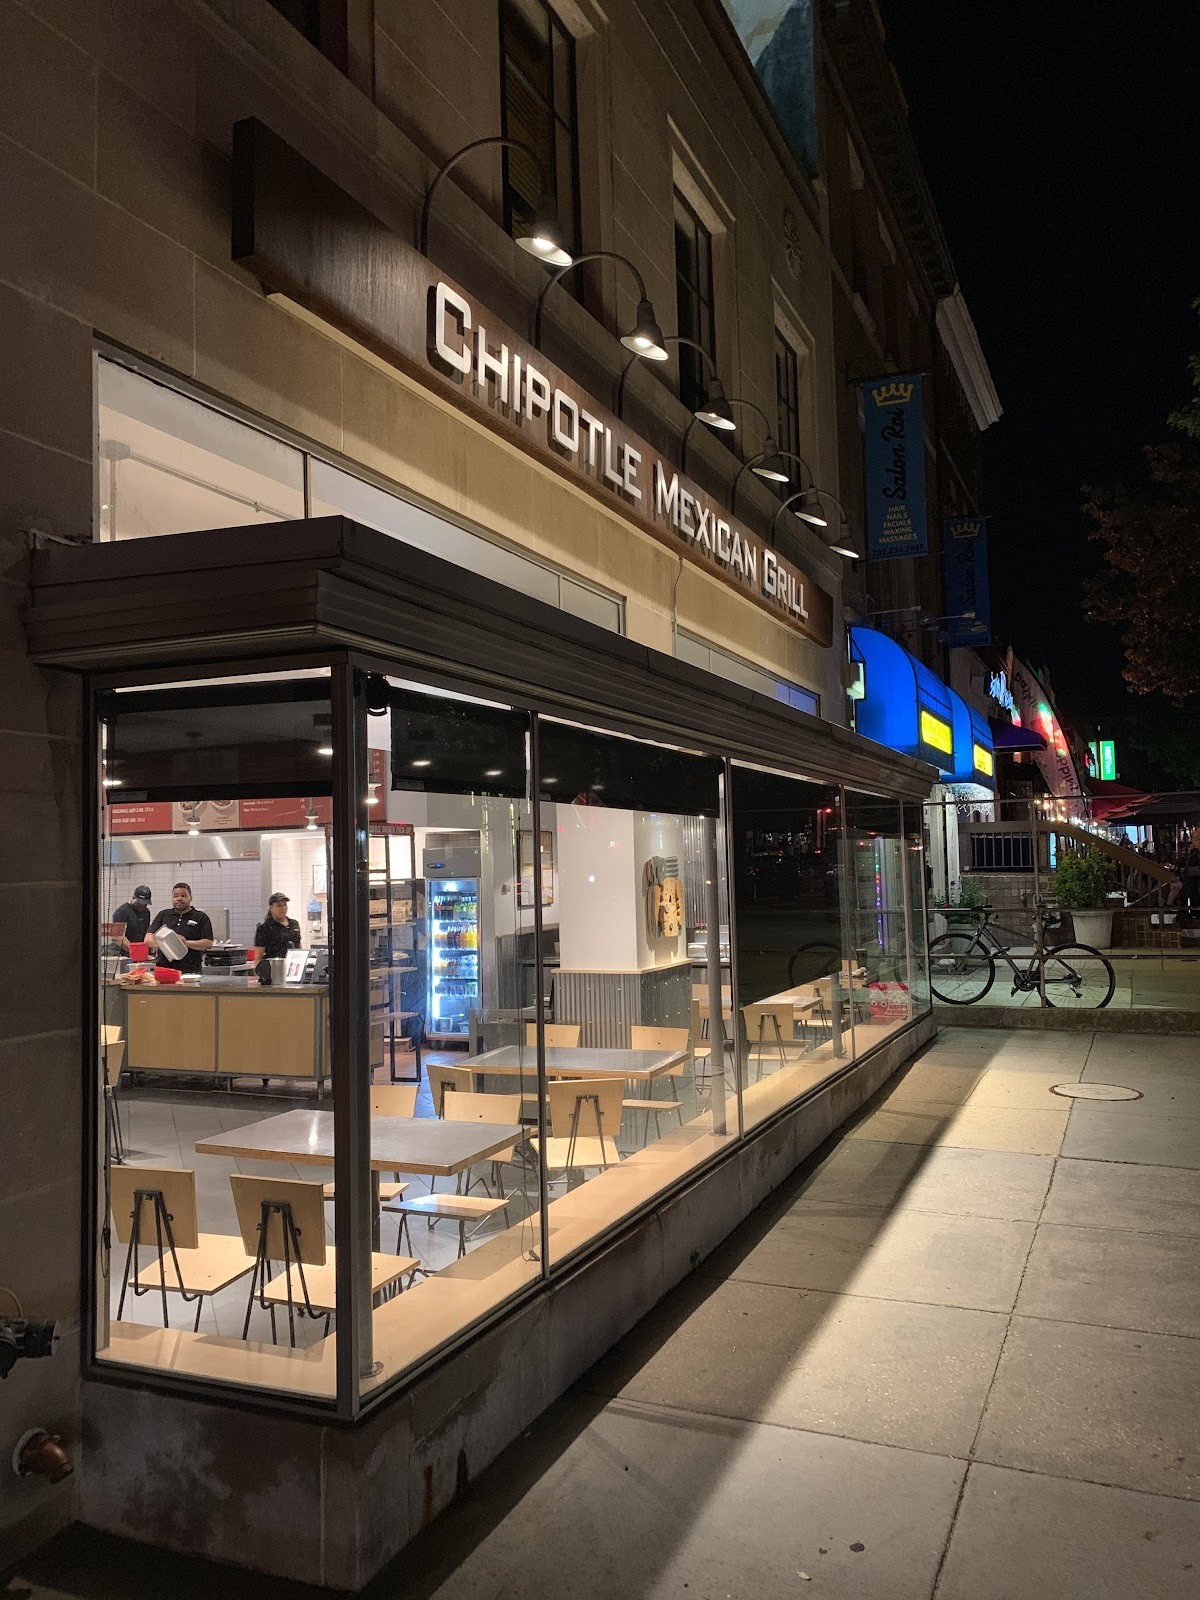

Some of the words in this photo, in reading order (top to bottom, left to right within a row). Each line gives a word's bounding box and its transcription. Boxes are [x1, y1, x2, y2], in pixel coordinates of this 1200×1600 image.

[880, 407, 905, 443] Roi
[435, 281, 642, 500] CHIPOTLE
[657, 459, 757, 582] MEXICAN
[764, 548, 809, 619] GRILL
[883, 446, 907, 500] Salon
[883, 519, 912, 528] FACIALS
[886, 512, 908, 520] NAILS
[879, 533, 918, 544] MASSAGES
[883, 526, 912, 535] WAXING
[959, 566, 976, 606] Salon
